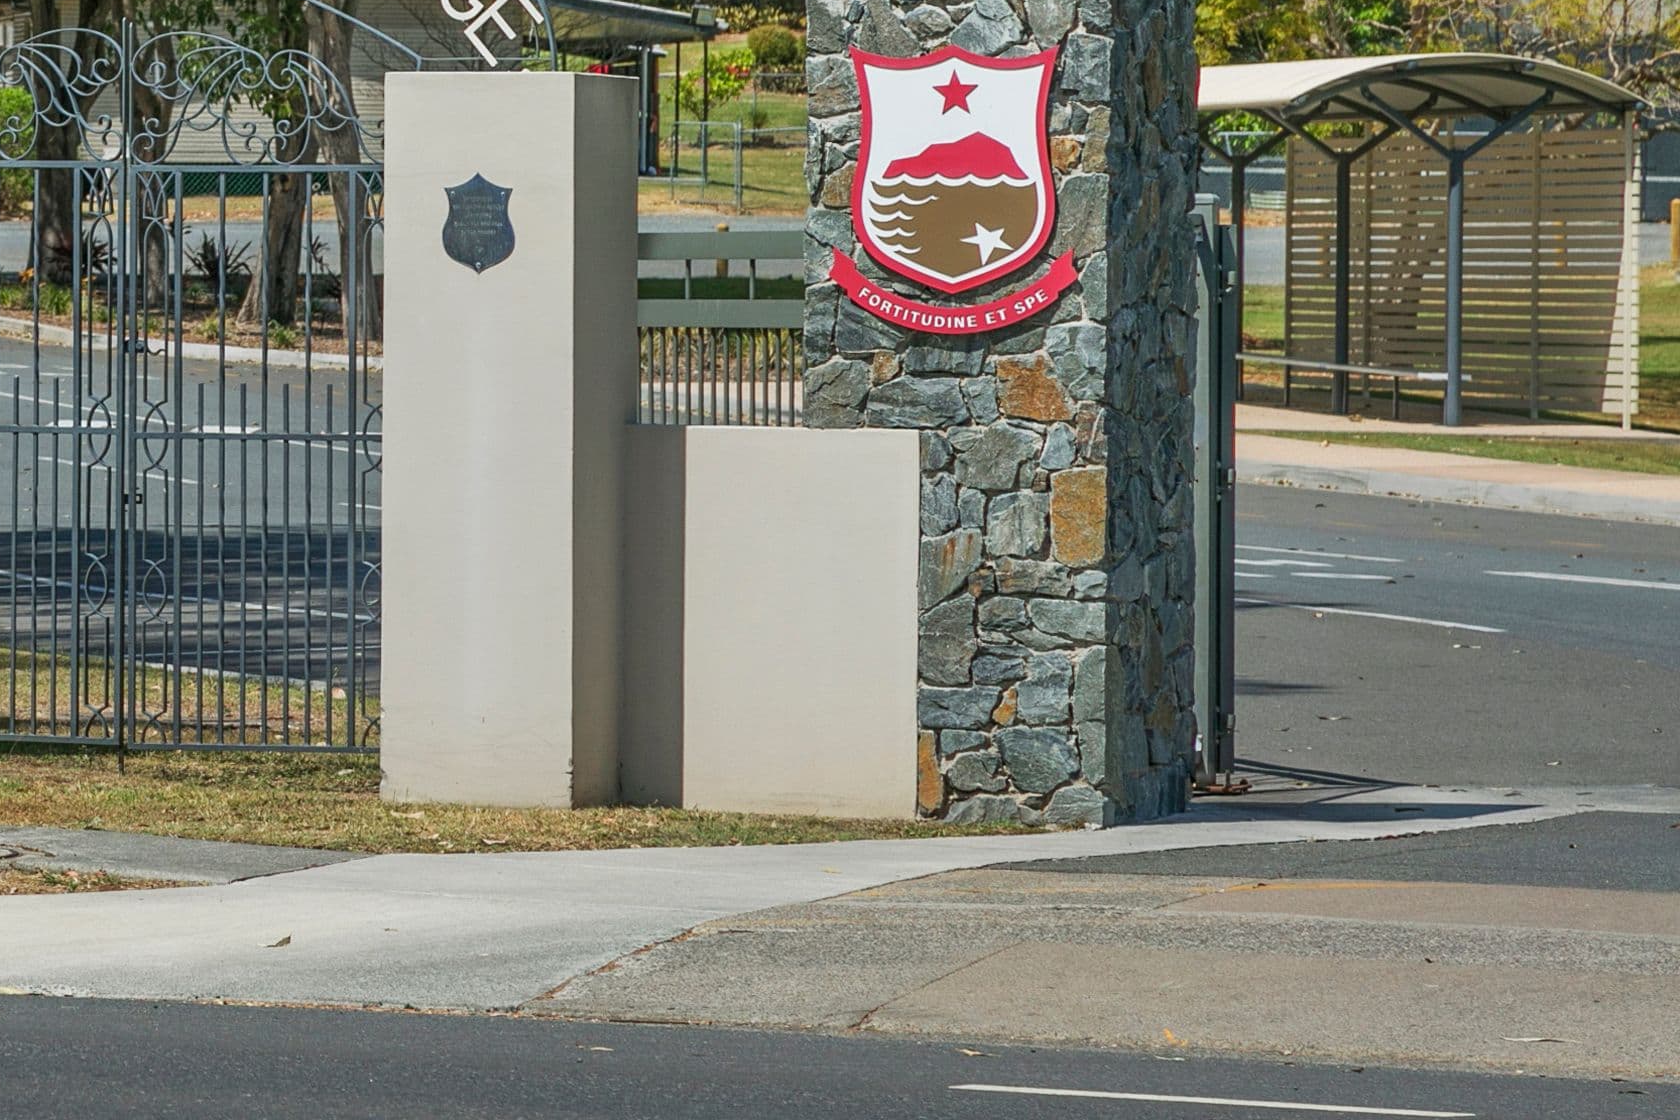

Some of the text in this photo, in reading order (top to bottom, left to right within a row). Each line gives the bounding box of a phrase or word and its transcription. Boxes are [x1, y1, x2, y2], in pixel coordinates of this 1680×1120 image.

[858, 287, 1049, 328] FORTITUDINE ET SPE
